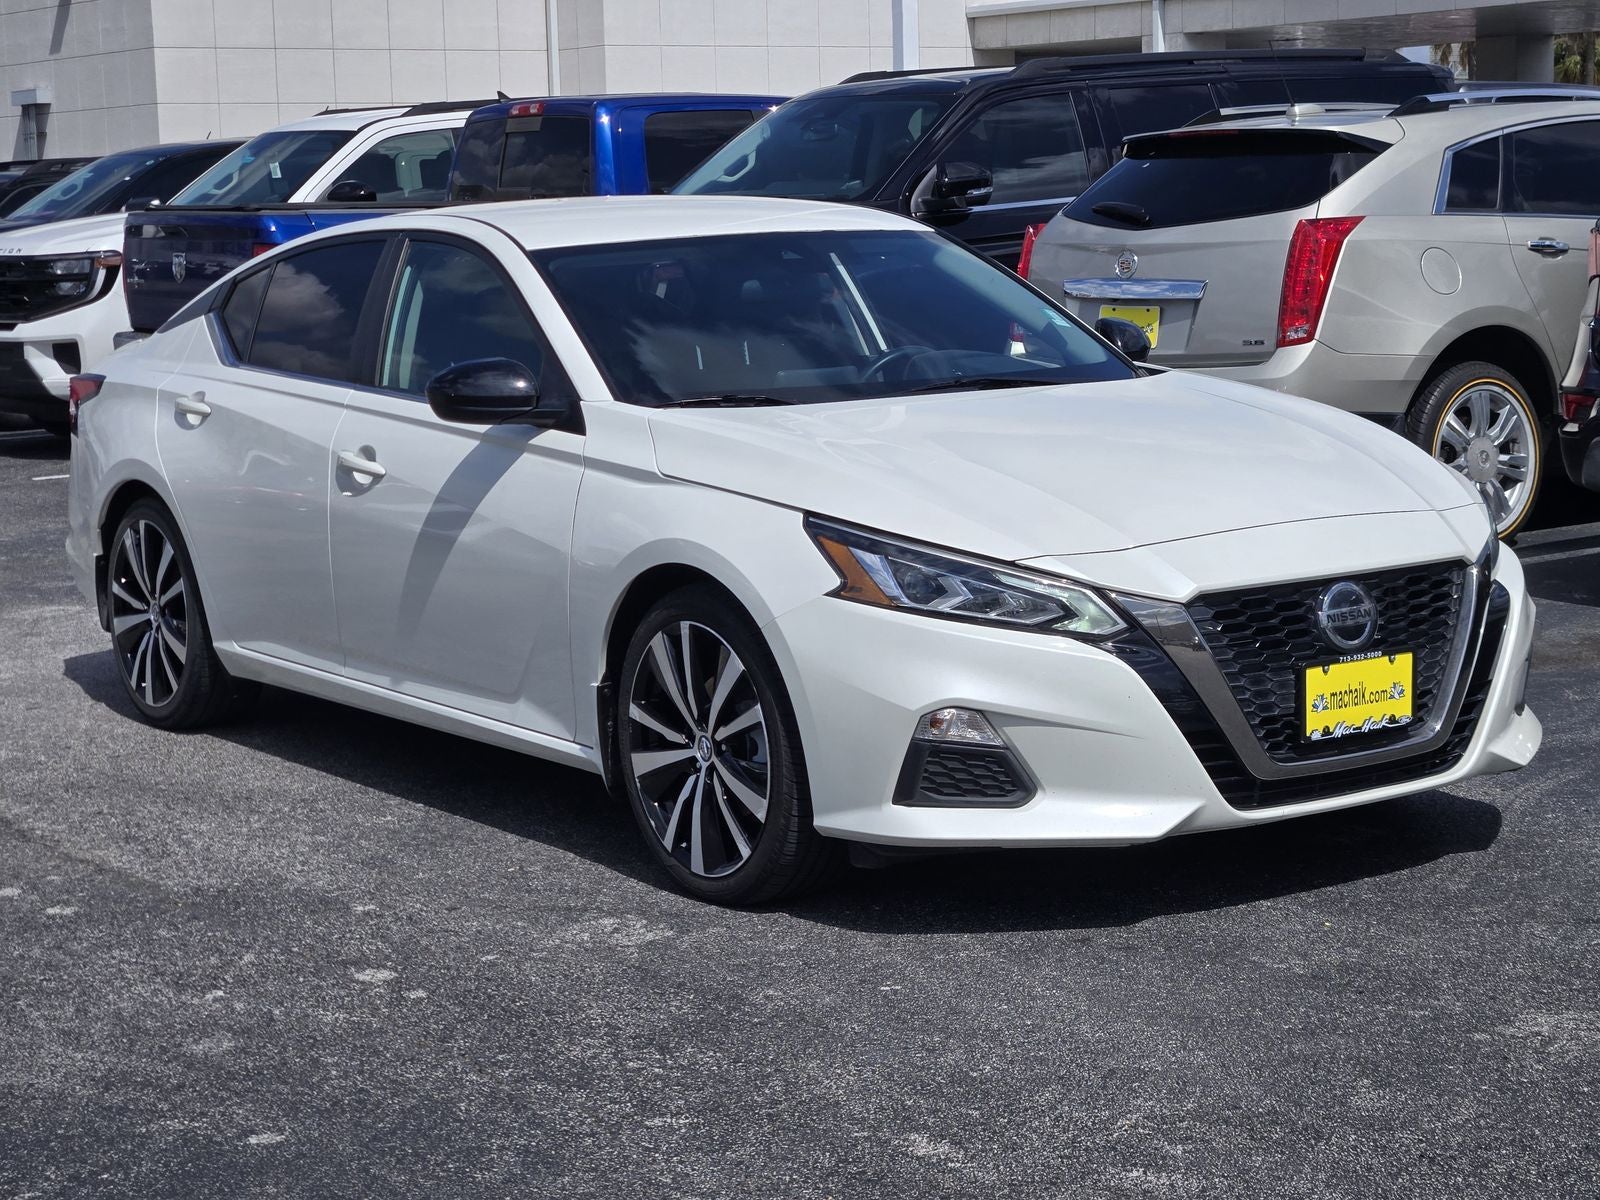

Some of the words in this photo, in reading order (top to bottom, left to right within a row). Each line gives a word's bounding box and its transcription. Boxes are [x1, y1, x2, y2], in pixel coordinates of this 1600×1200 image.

[1326, 608, 1372, 623] NISSAN
[1339, 651, 1382, 663] 713-932-5000
[1329, 681, 1388, 711] machaik.com
[1333, 721, 1357, 738] Mac
